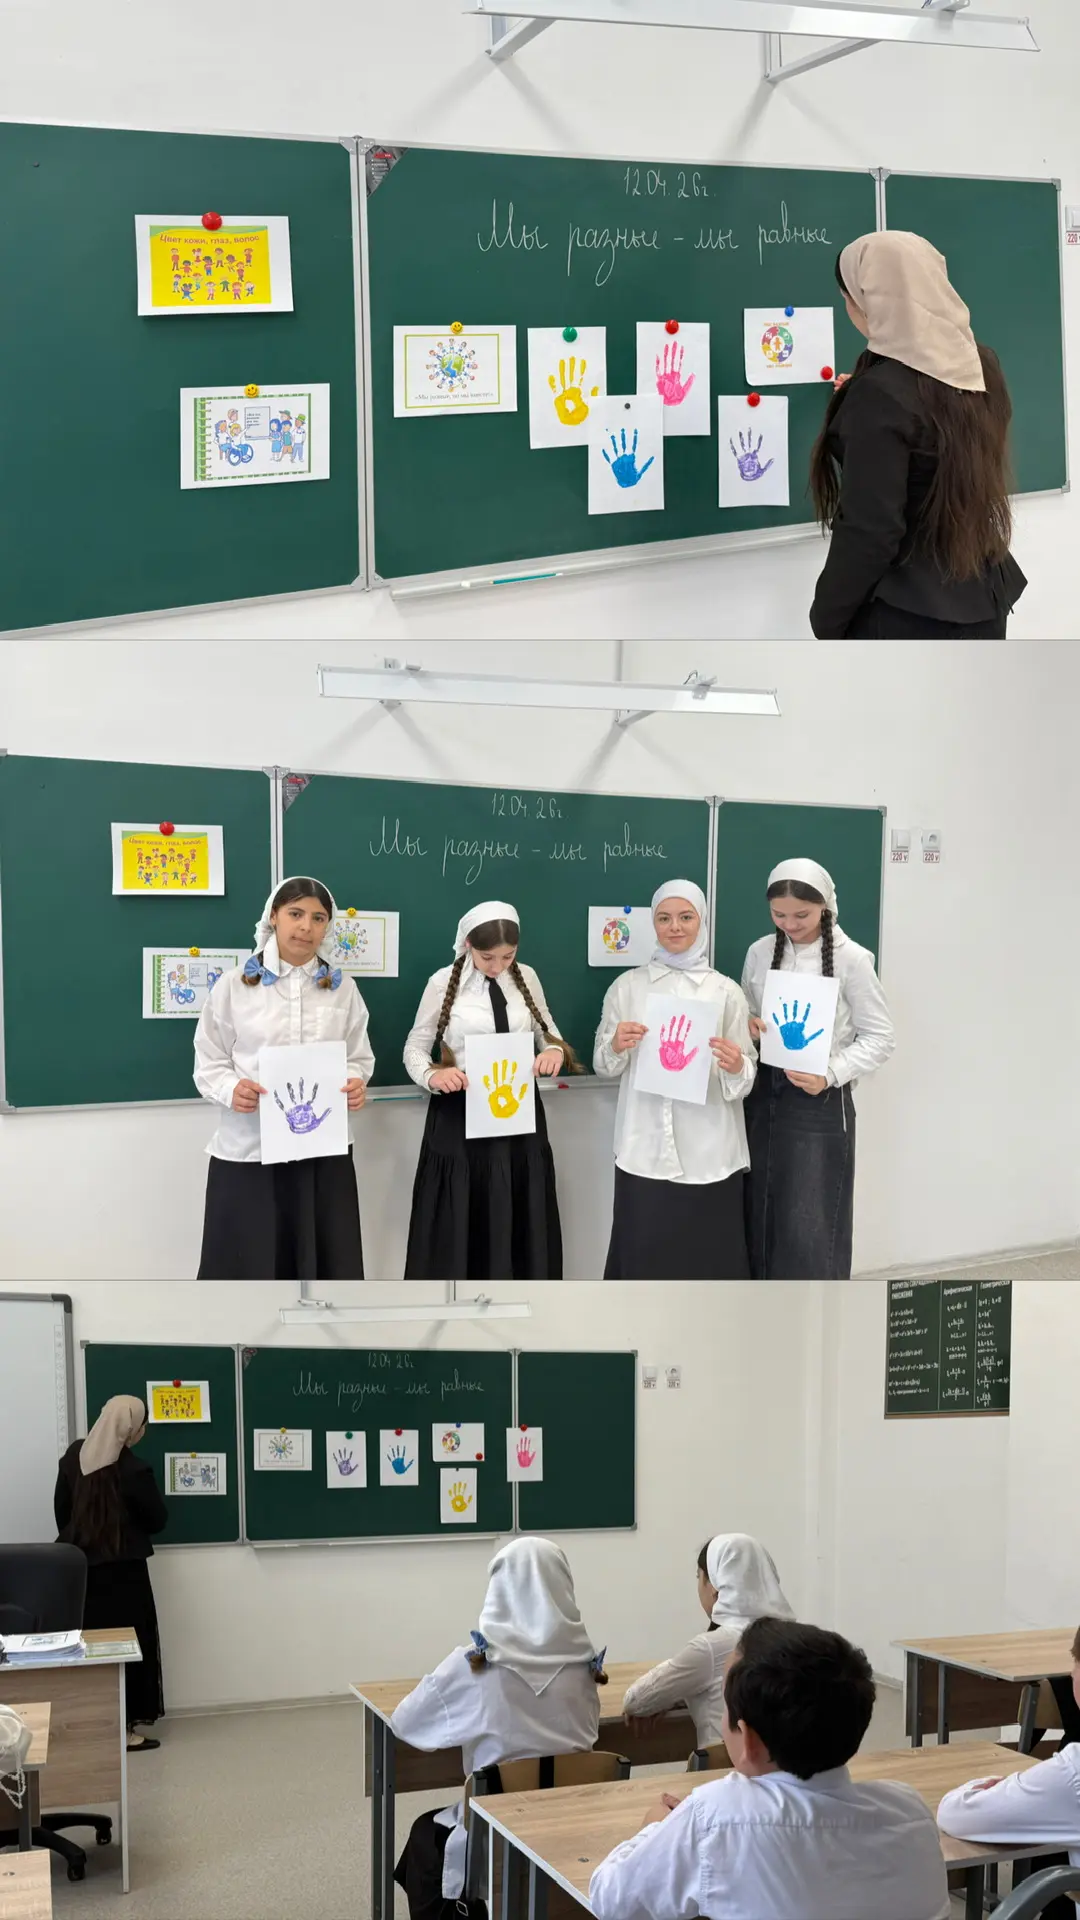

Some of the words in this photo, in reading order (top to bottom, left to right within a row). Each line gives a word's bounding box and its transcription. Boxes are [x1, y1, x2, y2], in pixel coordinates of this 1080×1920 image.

[159, 233, 182, 244] Цвет
[478, 198, 548, 252] Мы
[567, 222, 661, 287] разные
[694, 228, 739, 250] мы
[758, 200, 832, 266] равные
[1067, 233, 1078, 243] 220
[369, 815, 427, 857] Мы
[442, 834, 520, 886] разные
[549, 842, 588, 861] мы
[603, 821, 668, 873] равные
[892, 852, 903, 861] 220
[924, 852, 935, 861] 220
[292, 1370, 328, 1396] Мы
[337, 1380, 386, 1412] разные
[405, 1381, 430, 1394] мы
[440, 1368, 485, 1401] равные
